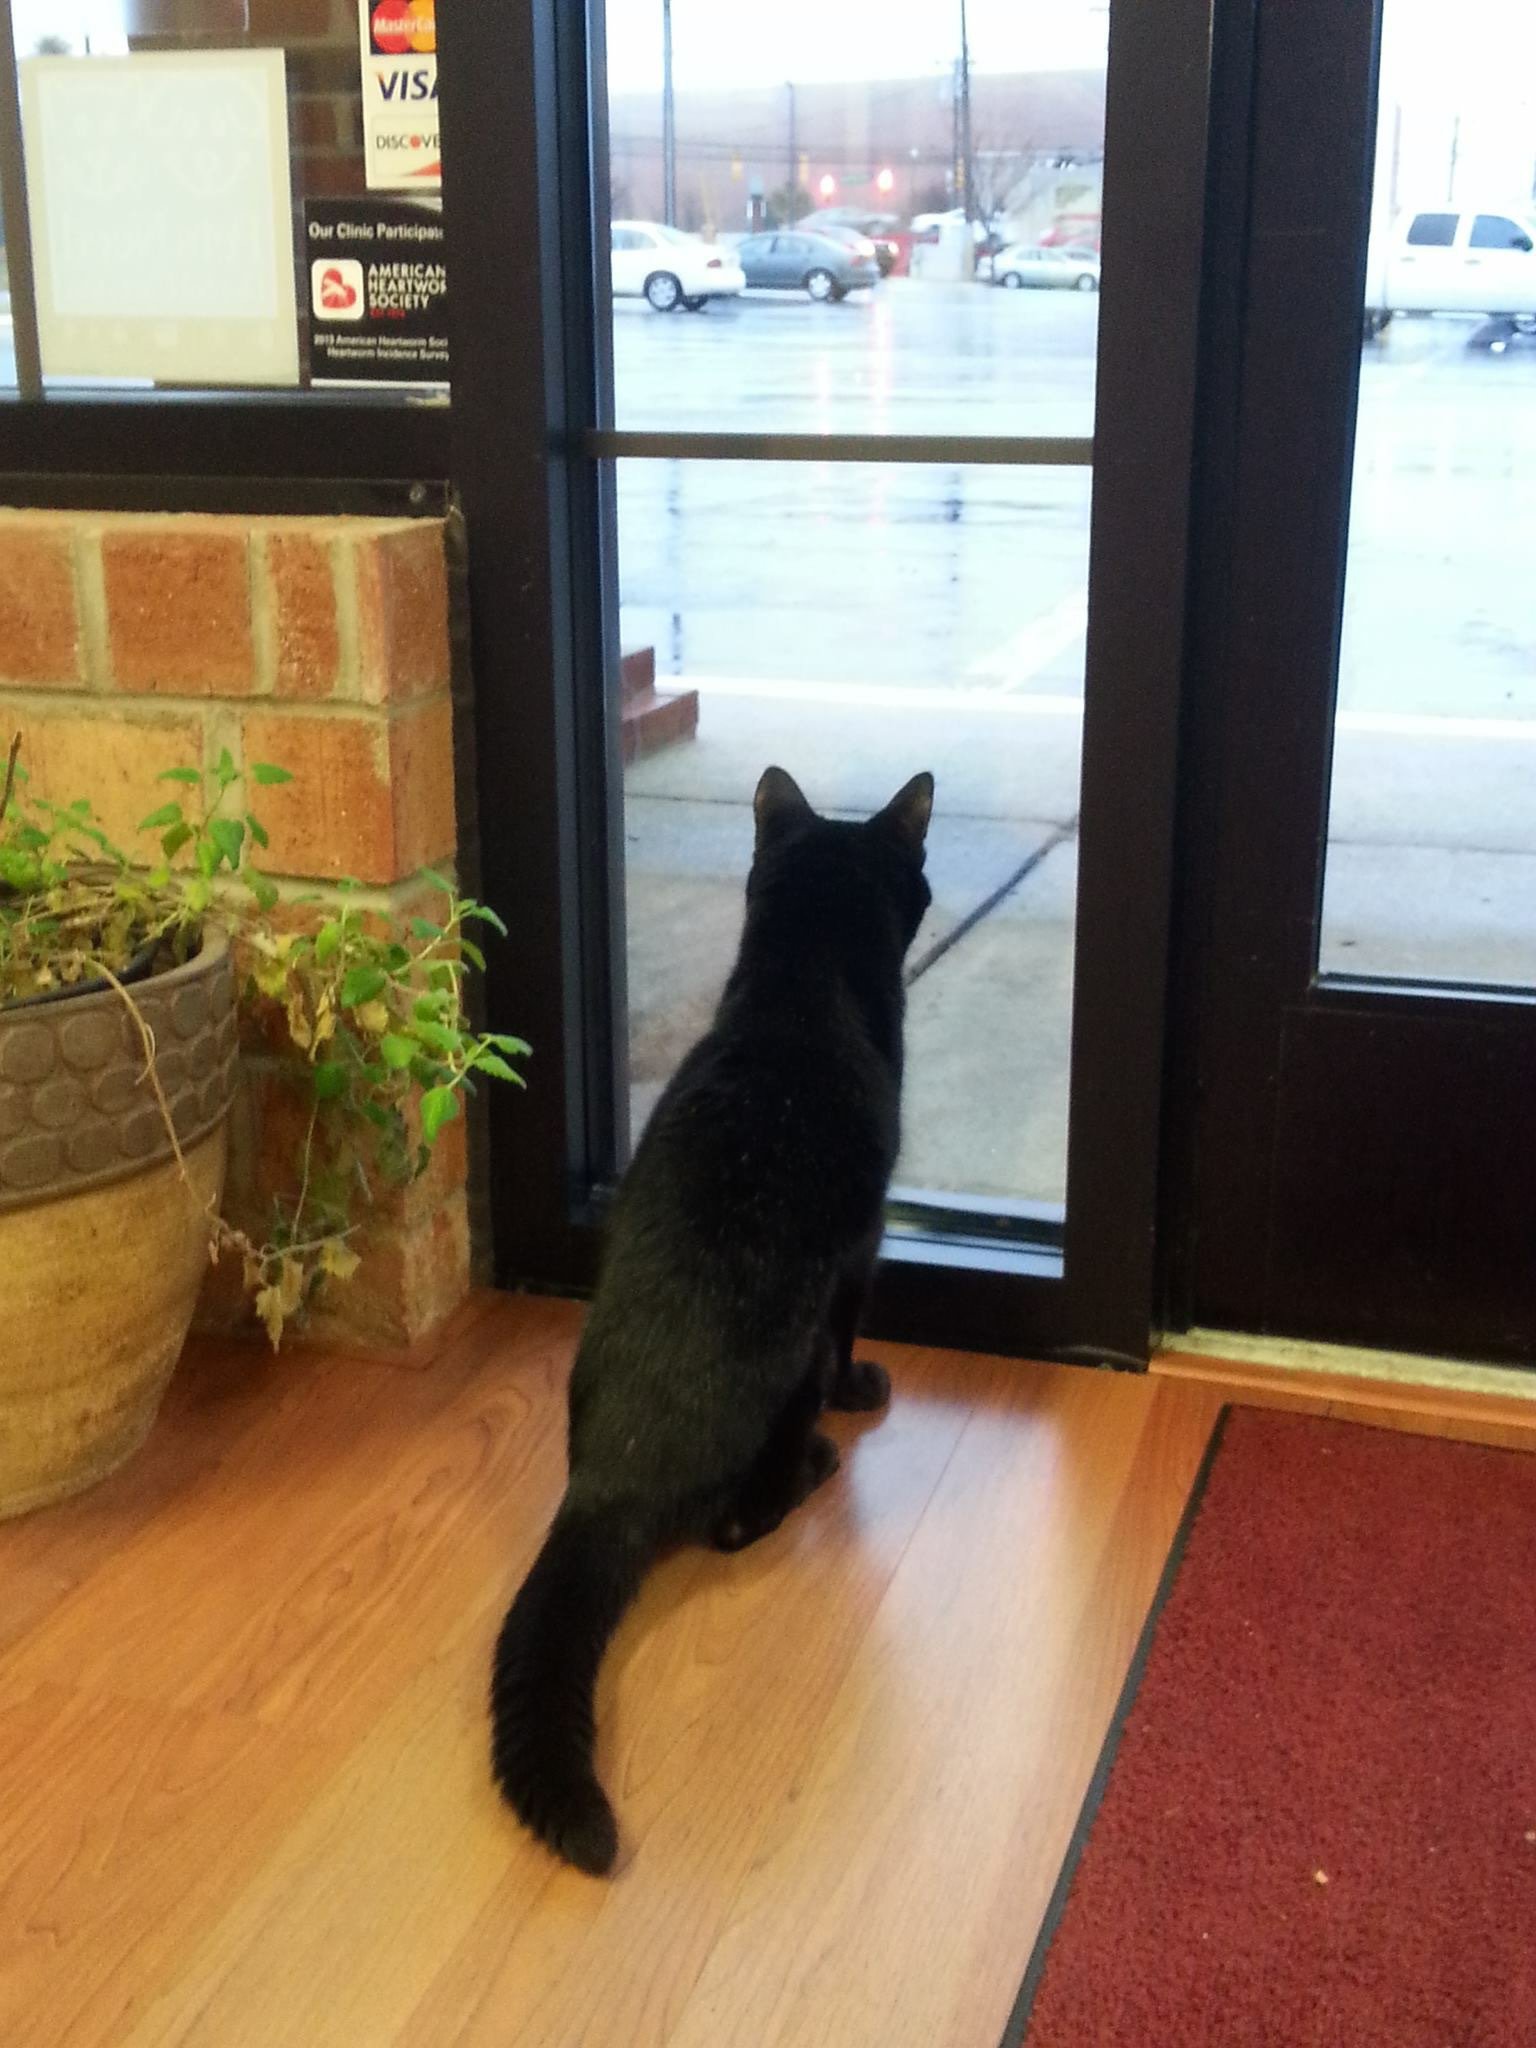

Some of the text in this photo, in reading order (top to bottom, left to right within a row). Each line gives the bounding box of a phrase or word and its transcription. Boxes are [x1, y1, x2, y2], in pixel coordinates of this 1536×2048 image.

[308, 221, 334, 239] Our
[337, 222, 374, 240] Clinic
[368, 263, 446, 279] AMERICAN
[369, 293, 430, 310] SOCIETY
